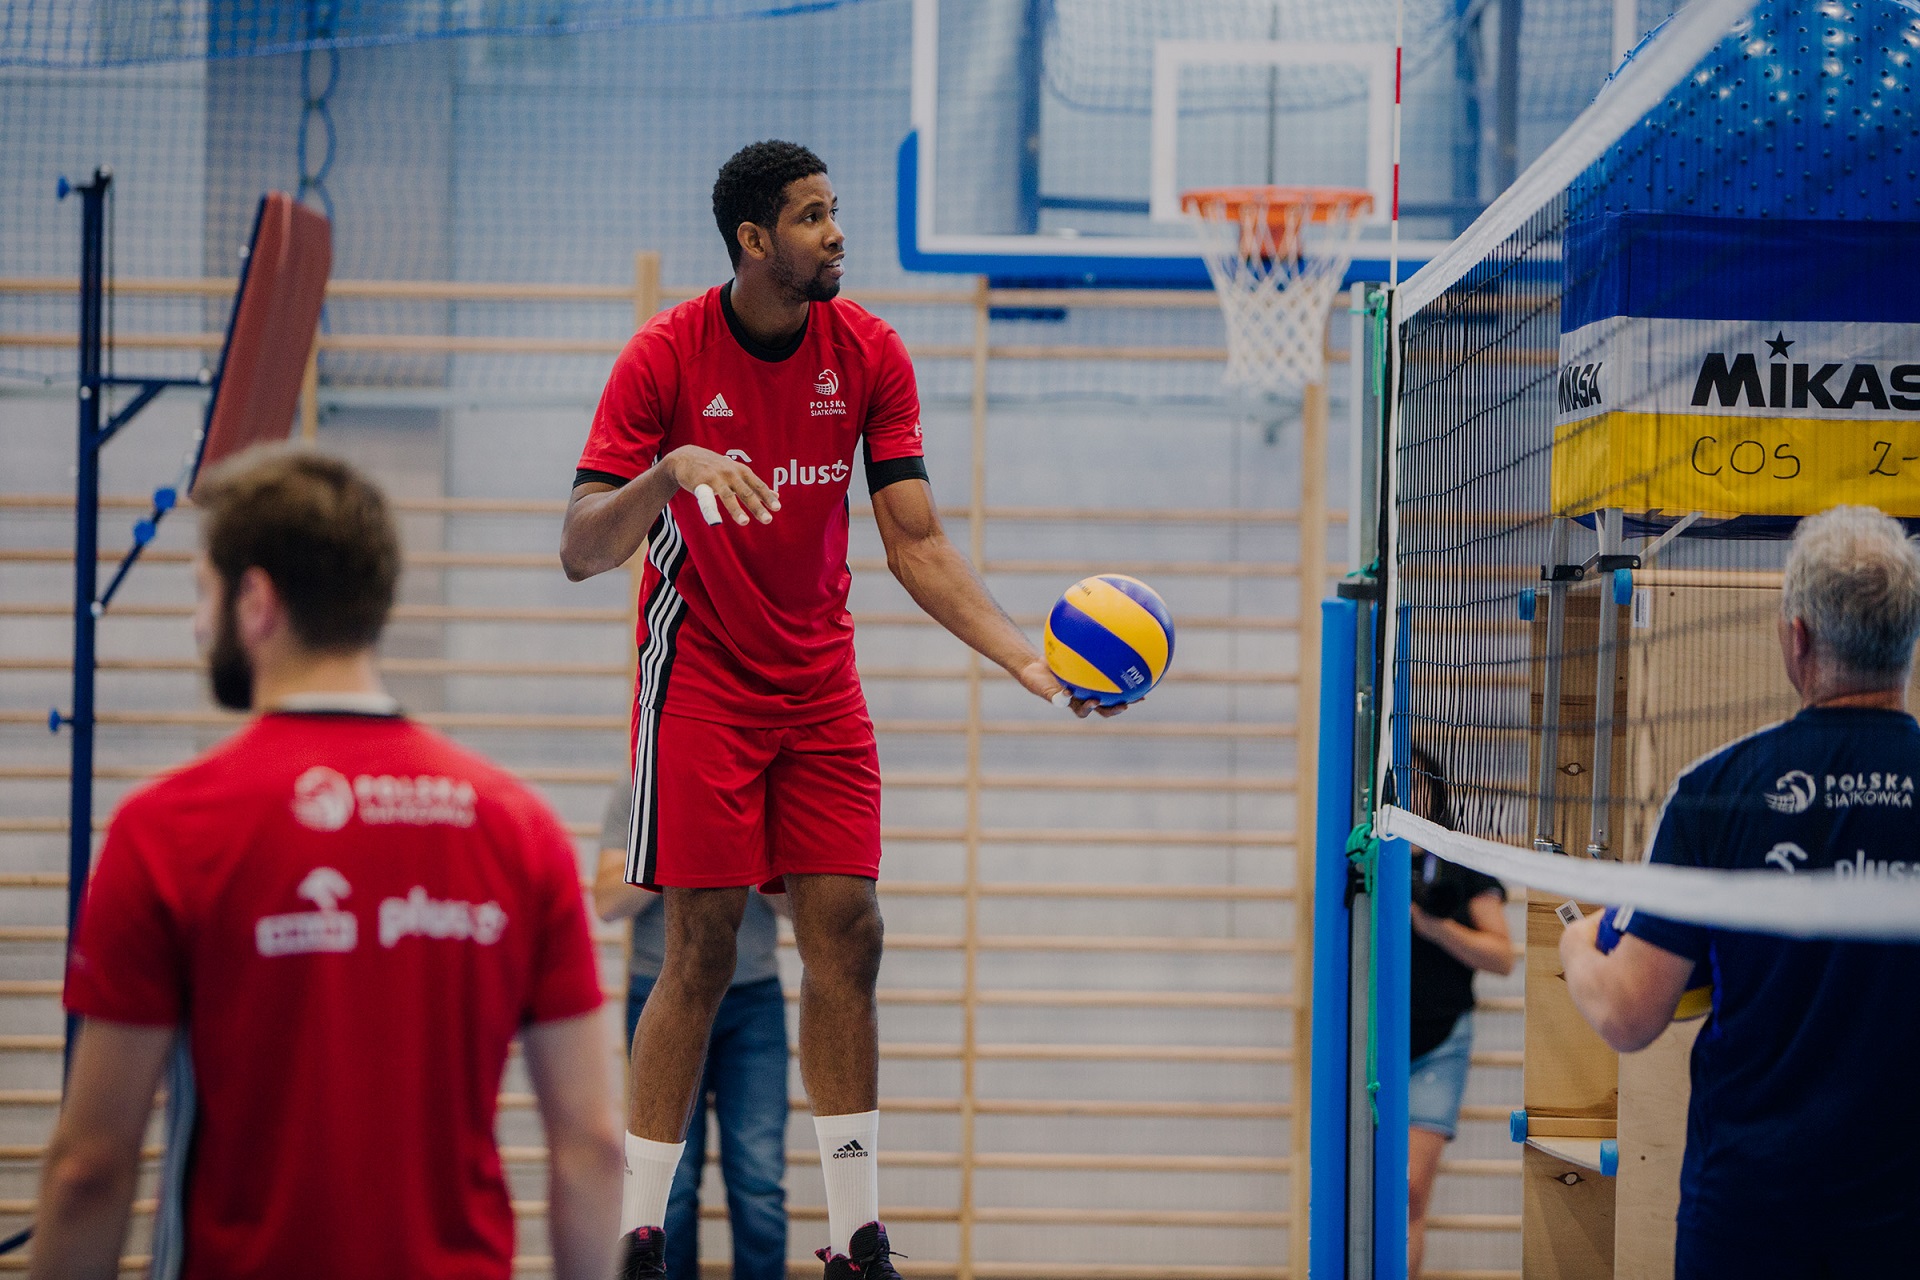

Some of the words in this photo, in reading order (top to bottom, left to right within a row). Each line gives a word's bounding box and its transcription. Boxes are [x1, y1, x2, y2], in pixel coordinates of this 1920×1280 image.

[810, 400, 847, 409] POLSKA
[702, 407, 734, 417] adidas
[1691, 435, 1801, 480] COS
[1826, 774, 1914, 791] POLSKA
[832, 1150, 869, 1159] adidas
